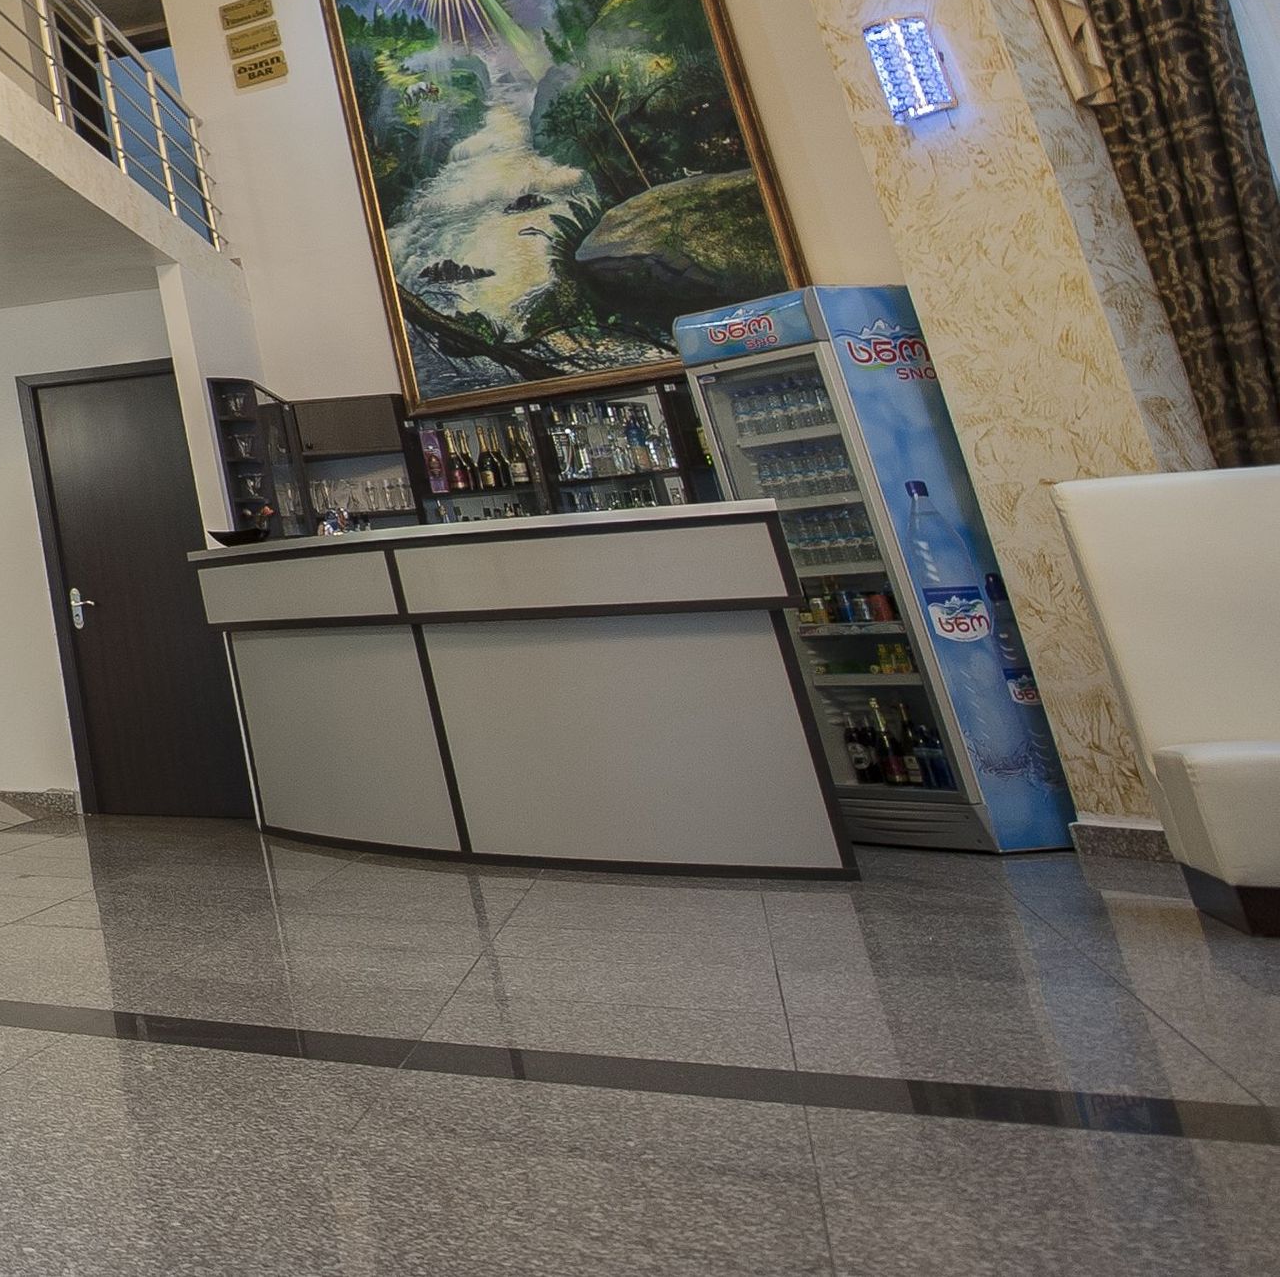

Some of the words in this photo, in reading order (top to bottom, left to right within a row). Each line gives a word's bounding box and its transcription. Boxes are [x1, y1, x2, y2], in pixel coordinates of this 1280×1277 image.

[247, 67, 274, 80] BAR
[708, 315, 773, 343] სნო
[847, 338, 931, 364] სნო
[896, 366, 938, 380] SNO
[938, 615, 990, 633] სნო
[1013, 688, 1039, 701] სნ
